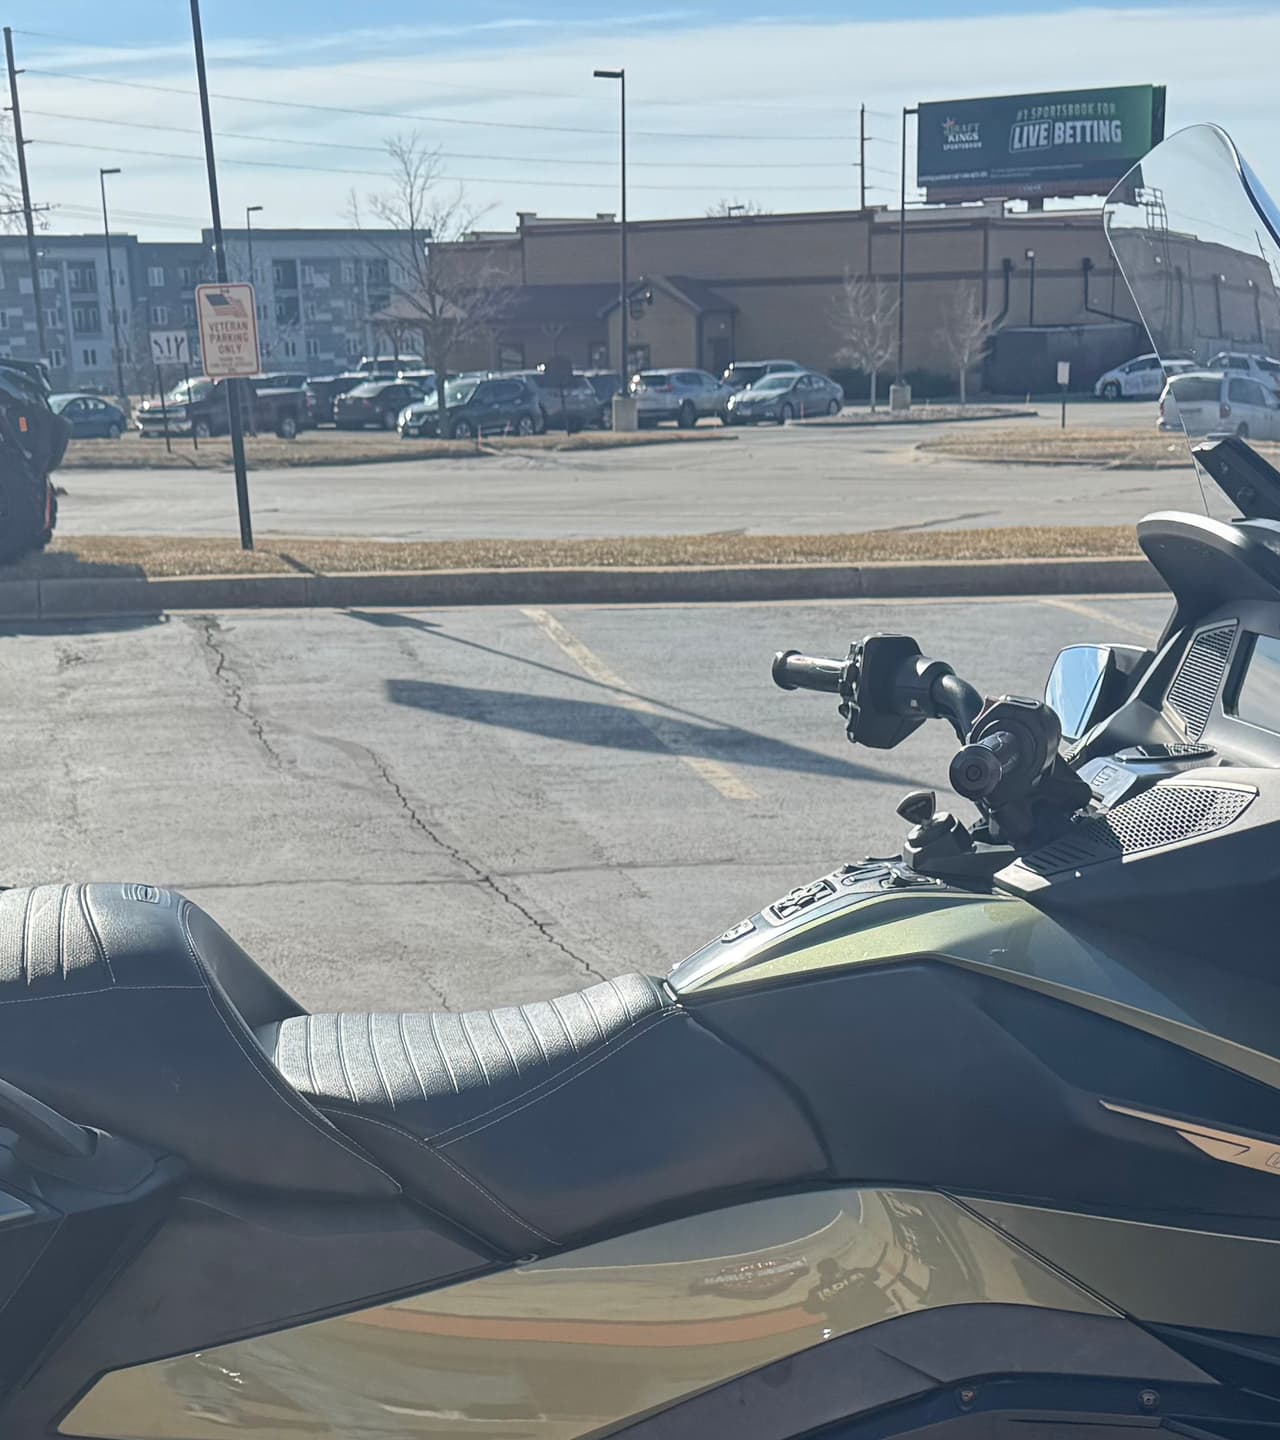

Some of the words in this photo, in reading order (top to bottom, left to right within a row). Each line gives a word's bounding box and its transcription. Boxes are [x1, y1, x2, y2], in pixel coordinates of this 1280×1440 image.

[1031, 103, 1095, 120] SPORTSBOOK
[1097, 102, 1116, 117] FOR
[947, 132, 979, 143] KINGS
[1013, 123, 1050, 149] LIVE
[1053, 119, 1122, 144] BETTING
[209, 321, 249, 332] VETERAN
[209, 332, 249, 344] PARKING
[218, 343, 242, 355] ONLY
